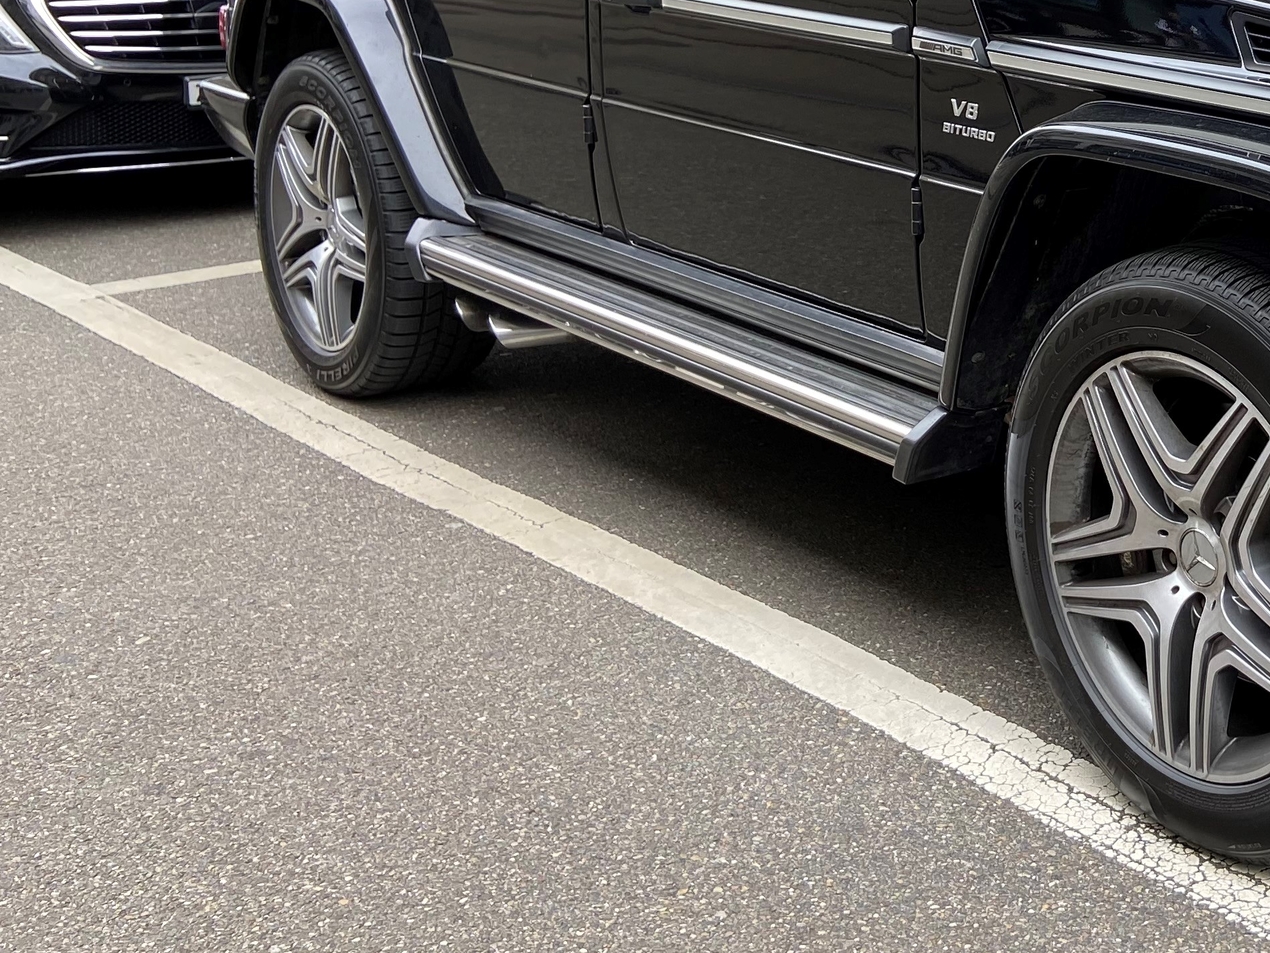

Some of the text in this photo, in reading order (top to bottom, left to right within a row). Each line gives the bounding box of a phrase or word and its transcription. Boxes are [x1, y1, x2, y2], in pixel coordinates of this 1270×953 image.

[932, 44, 963, 56] AMG
[299, 75, 362, 169] SCORPION
[950, 98, 979, 120] V8
[942, 122, 996, 142] BITURBO
[317, 344, 359, 383] PIRELLI
[1027, 297, 1174, 400] SCORPION
